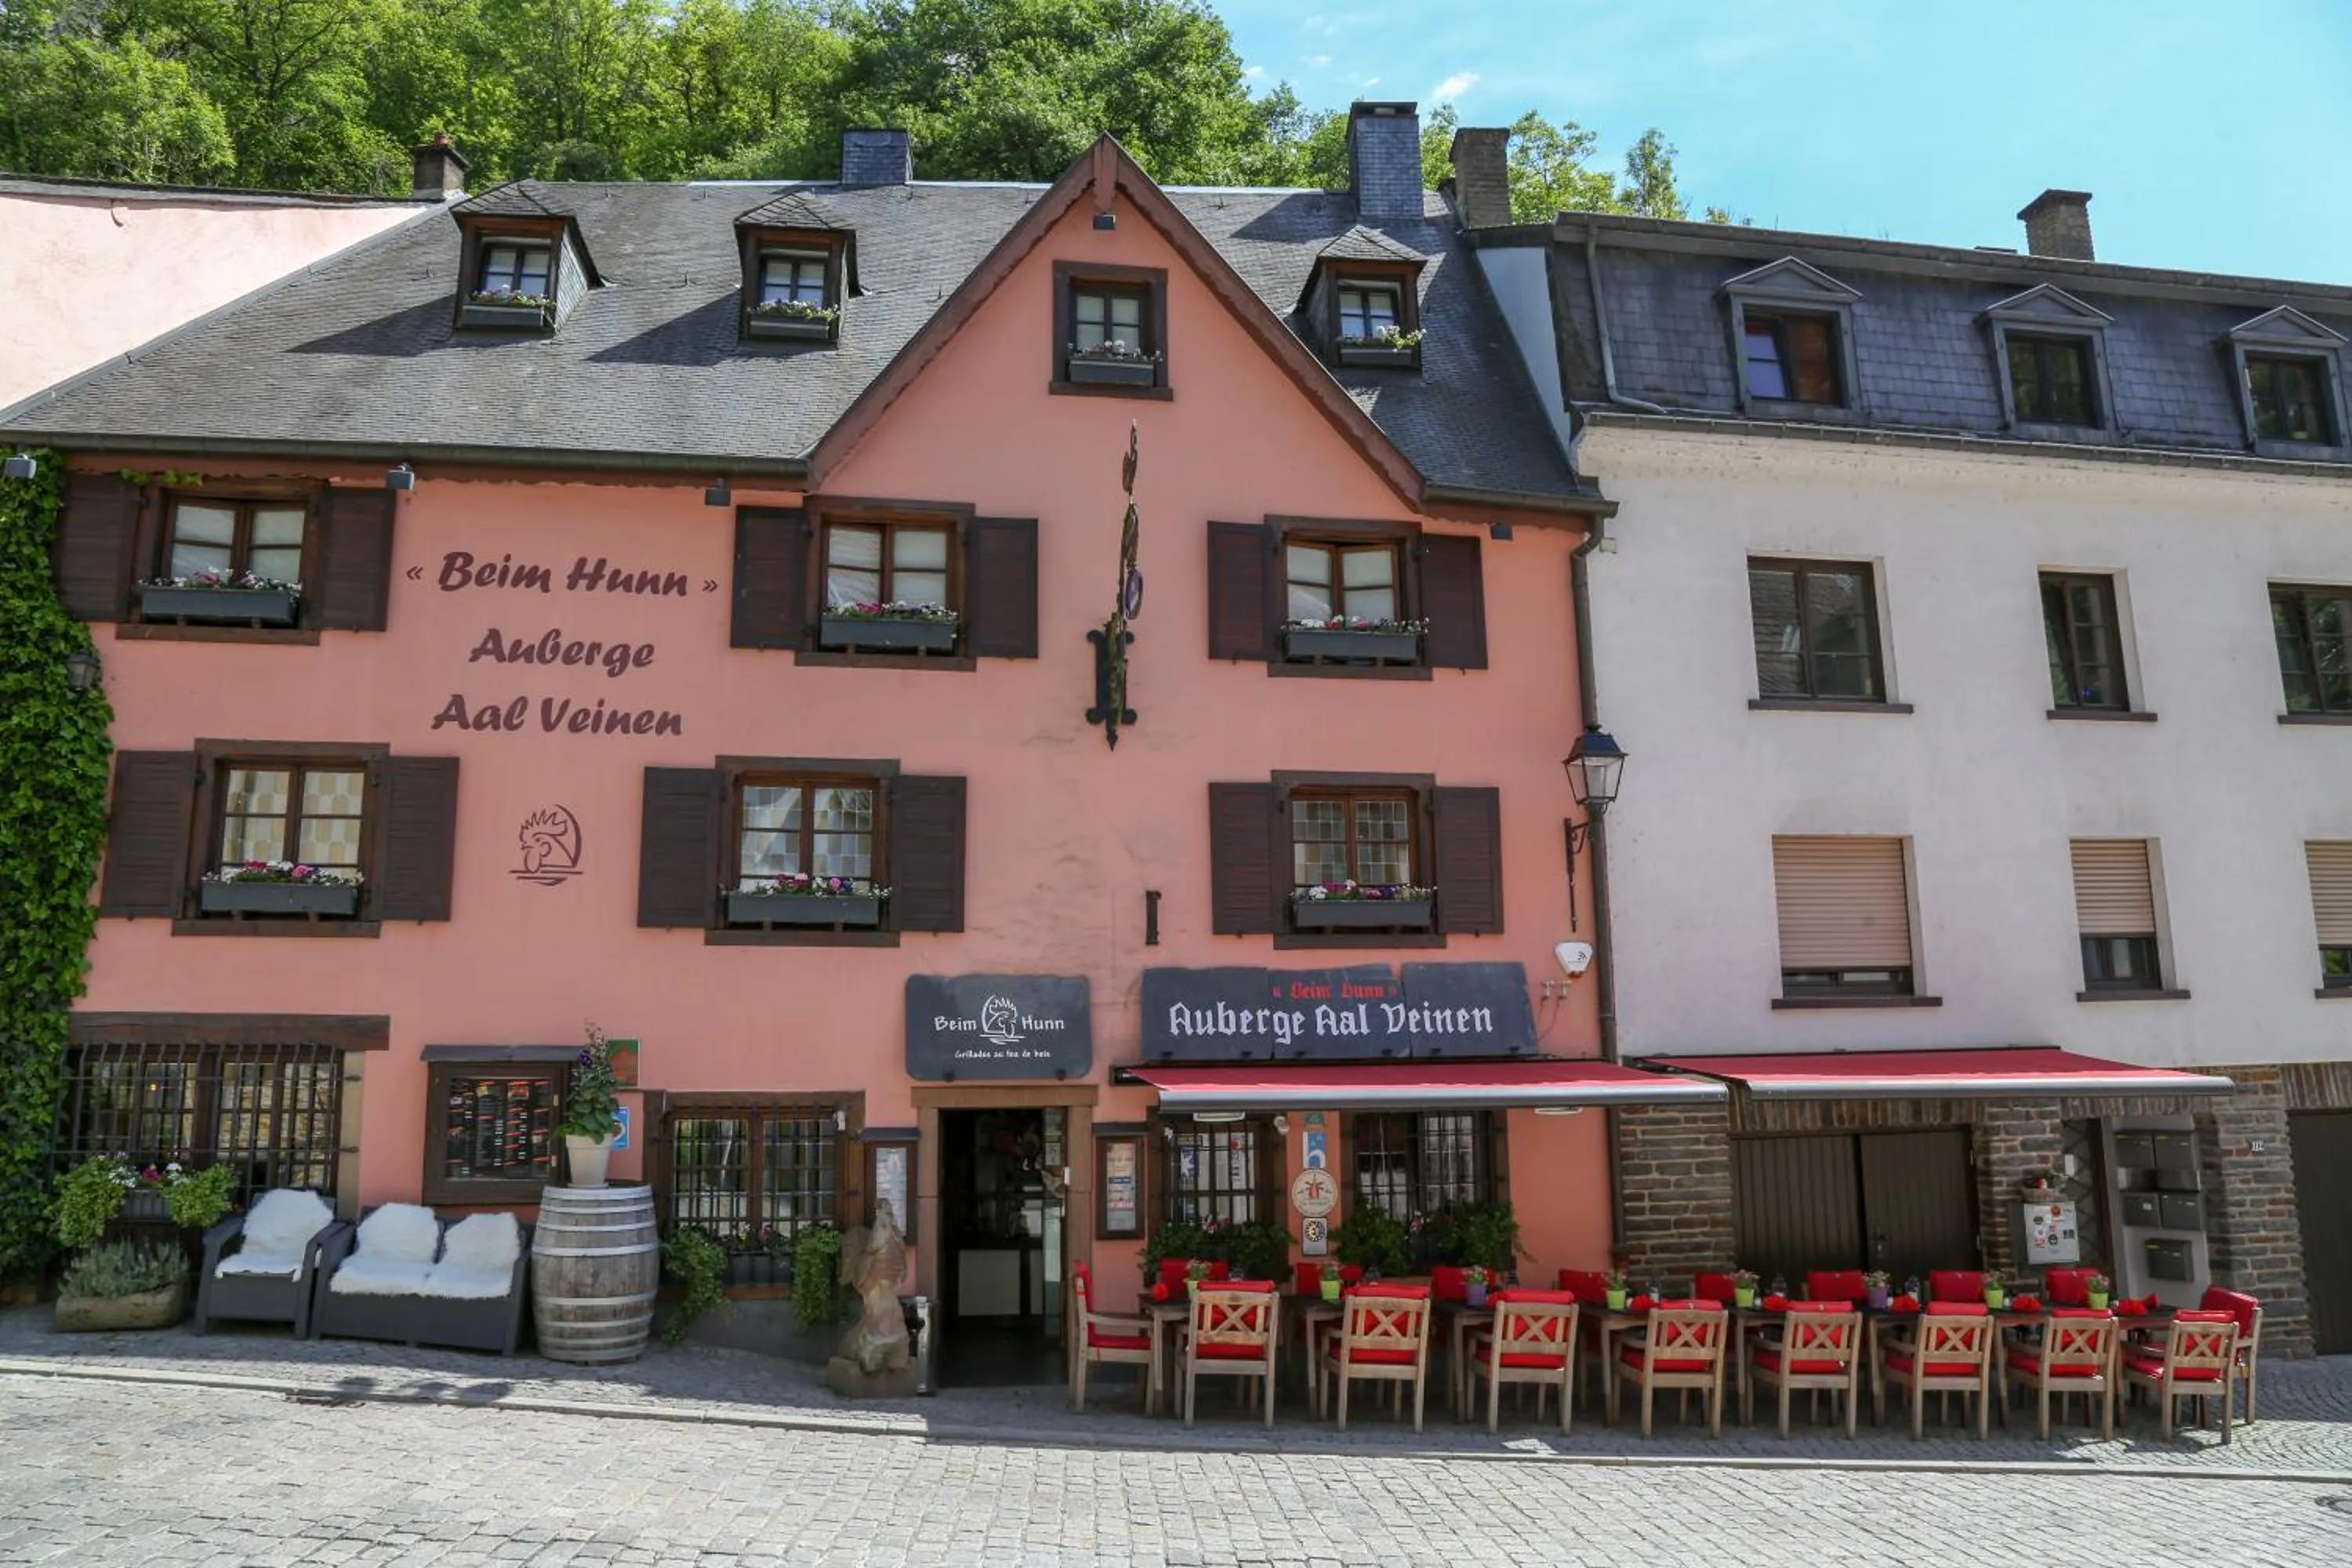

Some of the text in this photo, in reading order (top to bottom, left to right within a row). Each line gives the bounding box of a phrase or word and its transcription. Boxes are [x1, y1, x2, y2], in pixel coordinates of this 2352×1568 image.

[438, 551, 552, 593] Beim
[566, 557, 688, 597] Hunn
[469, 628, 655, 678] Auberge
[430, 694, 682, 736] Aal Veinen
[935, 1015, 1065, 1031] Beim Hunn
[1169, 1000, 1493, 1044] Auberge Aal Veinen
